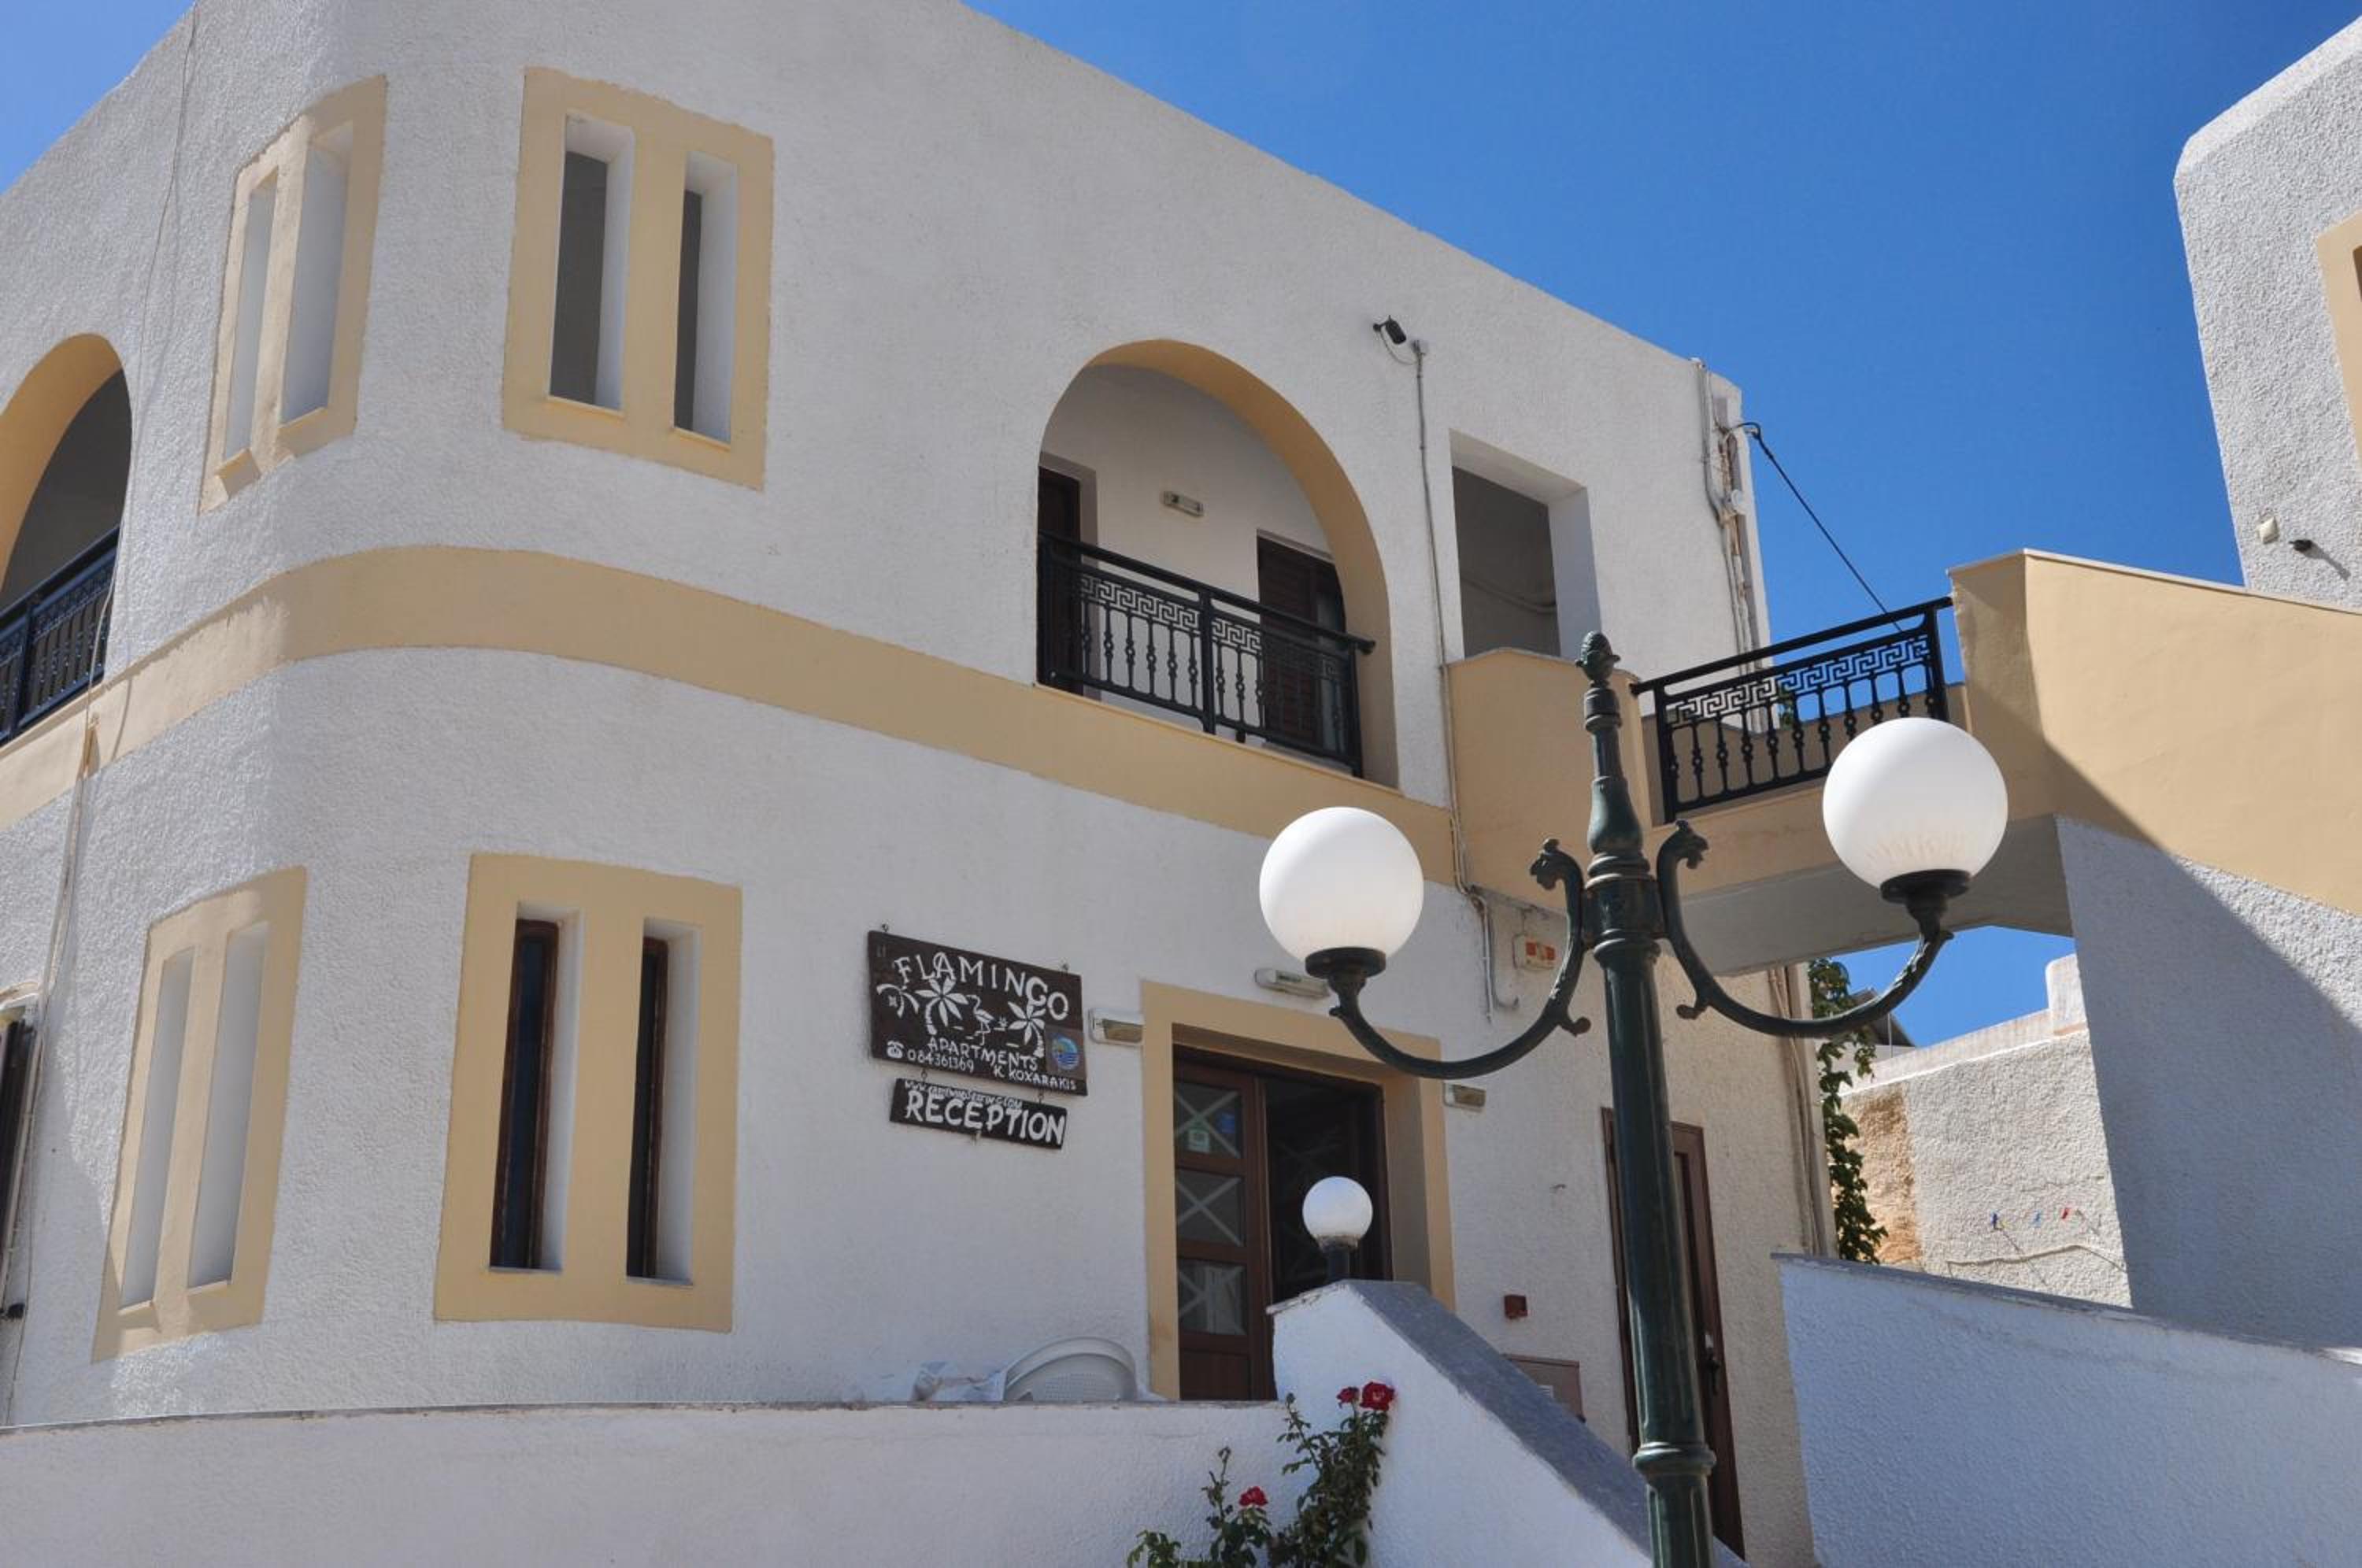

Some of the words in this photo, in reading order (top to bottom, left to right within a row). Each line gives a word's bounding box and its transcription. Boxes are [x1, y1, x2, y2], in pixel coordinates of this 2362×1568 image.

[894, 952, 1069, 1021] FLAMINGO
[927, 1037, 1038, 1071] APARTMENTS
[905, 1091, 1064, 1145] RECEPTION
